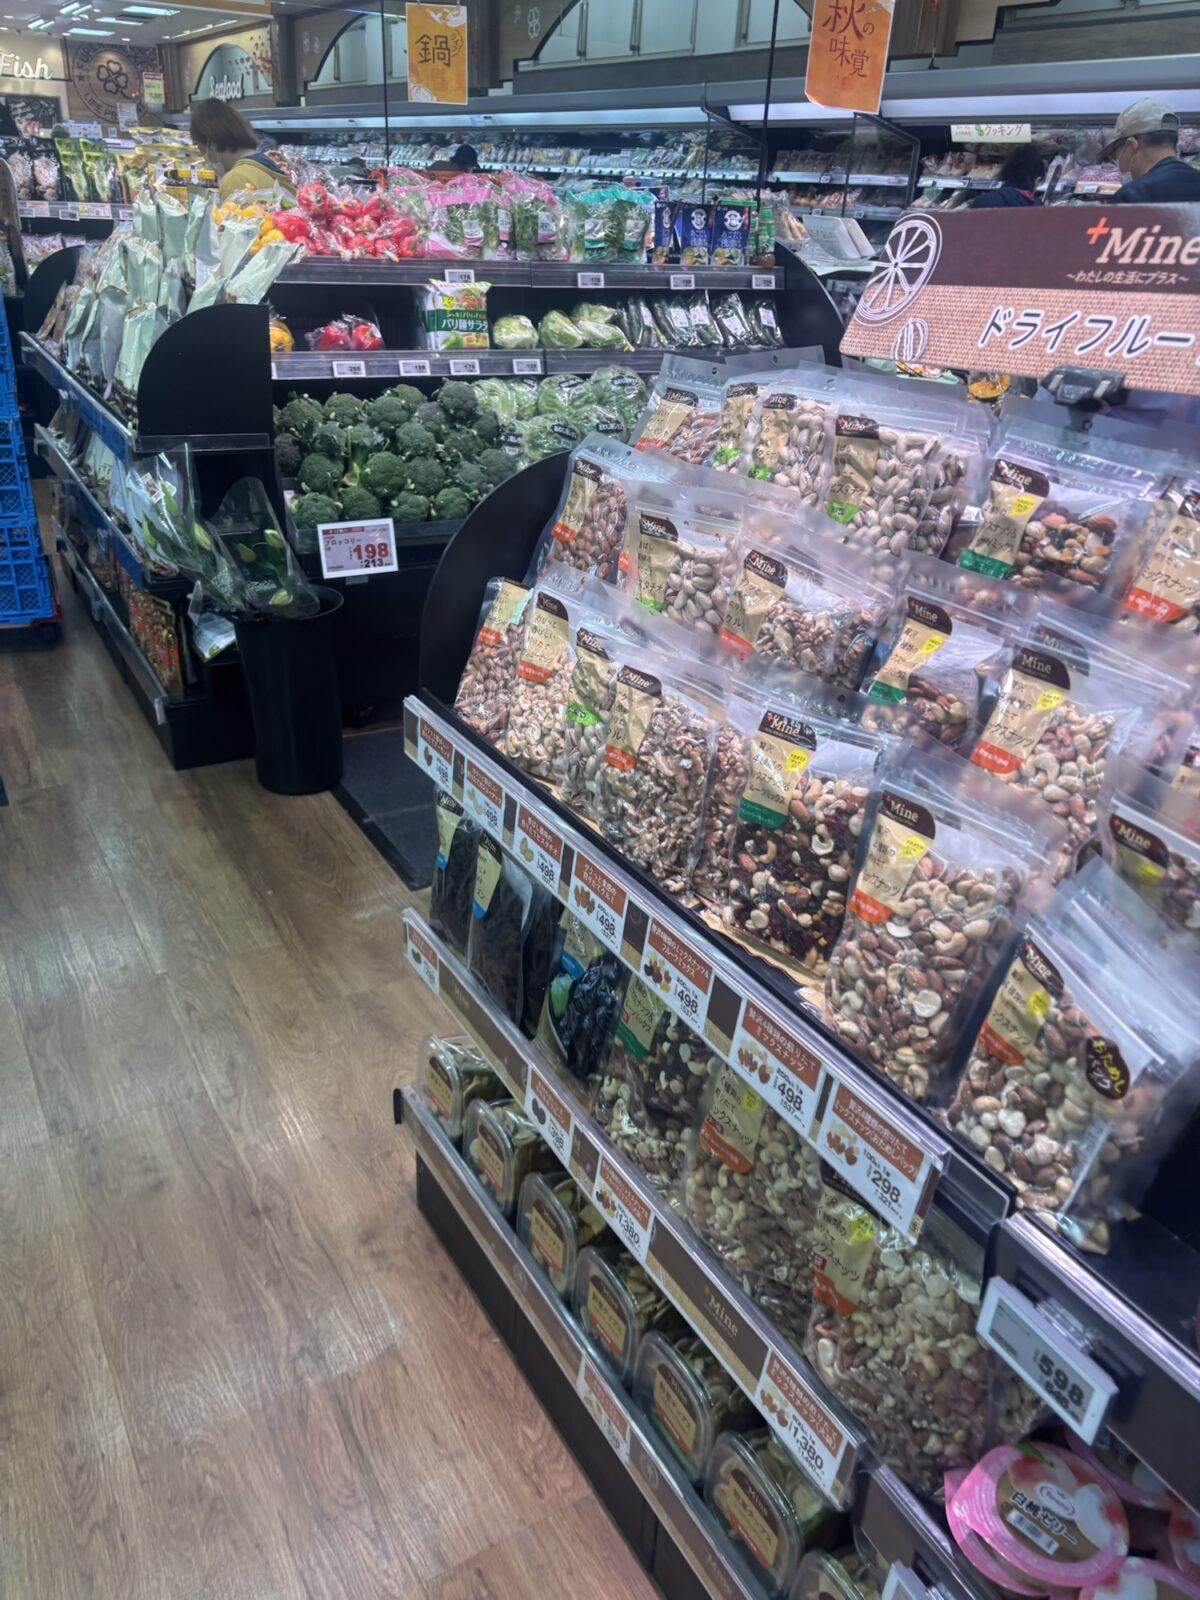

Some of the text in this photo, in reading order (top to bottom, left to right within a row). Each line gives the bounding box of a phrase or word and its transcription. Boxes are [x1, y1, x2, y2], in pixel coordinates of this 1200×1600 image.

[822, 0, 875, 41] 秋の
[0, 51, 53, 80] Fish
[415, 33, 451, 68] 鍋
[829, 34, 870, 78] 味覚
[209, 73, 244, 101] Seafood
[984, 123, 1024, 137] クッキング
[978, 305, 1200, 367] ドライフルー
[353, 543, 389, 560] 198
[364, 558, 384, 568] 213
[754, 558, 776, 576] Mine
[1140, 566, 1199, 595] ミックスナッツ
[639, 580, 664, 592] スタチオ
[914, 605, 940, 622] Mine
[1020, 652, 1053, 674] Mine
[626, 669, 651, 688] Mine
[770, 717, 802, 737] Mine
[890, 801, 919, 823] Mine
[1118, 821, 1152, 849] Mine
[539, 859, 555, 883] 498
[598, 911, 615, 938] 498
[1025, 948, 1053, 980] Mine
[676, 985, 698, 1015] 498
[992, 1010, 1032, 1046] ックスナッツ
[755, 1024, 805, 1075] ミックスナッツ
[1092, 1038, 1126, 1094] おためし
[776, 1078, 803, 1113] 498
[713, 1108, 754, 1146] ックスナッツ
[870, 1167, 901, 1205] 298
[618, 1212, 639, 1249] 1,380
[708, 1296, 740, 1338] Mine
[1038, 1353, 1085, 1407] 598
[790, 1423, 824, 1473] 1,380
[1010, 1491, 1078, 1545] 白桃ゼリー
